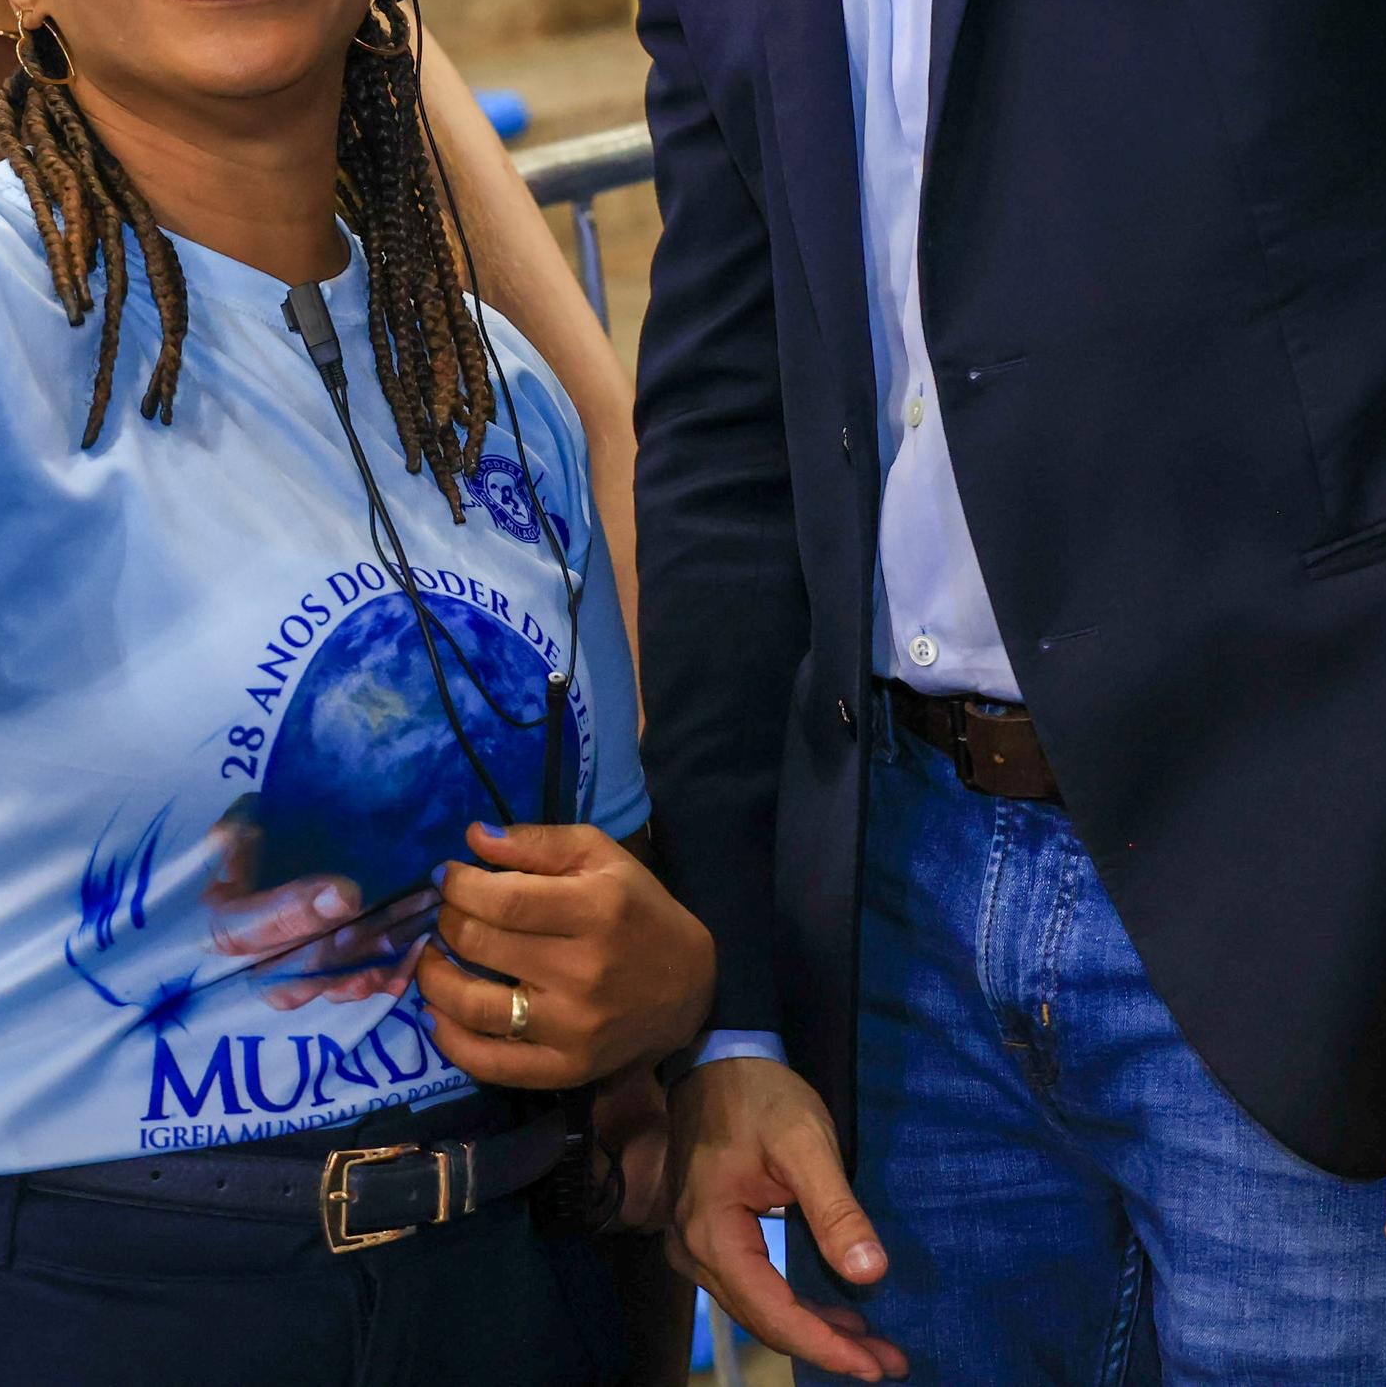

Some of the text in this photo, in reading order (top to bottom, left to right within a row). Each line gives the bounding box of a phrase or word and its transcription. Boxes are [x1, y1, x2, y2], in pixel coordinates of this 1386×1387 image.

[221, 724, 265, 779] 28
[245, 593, 331, 716] ANOS
[325, 562, 386, 606] DO
[522, 612, 561, 669] DE
[139, 1122, 232, 1150] IGREJA
